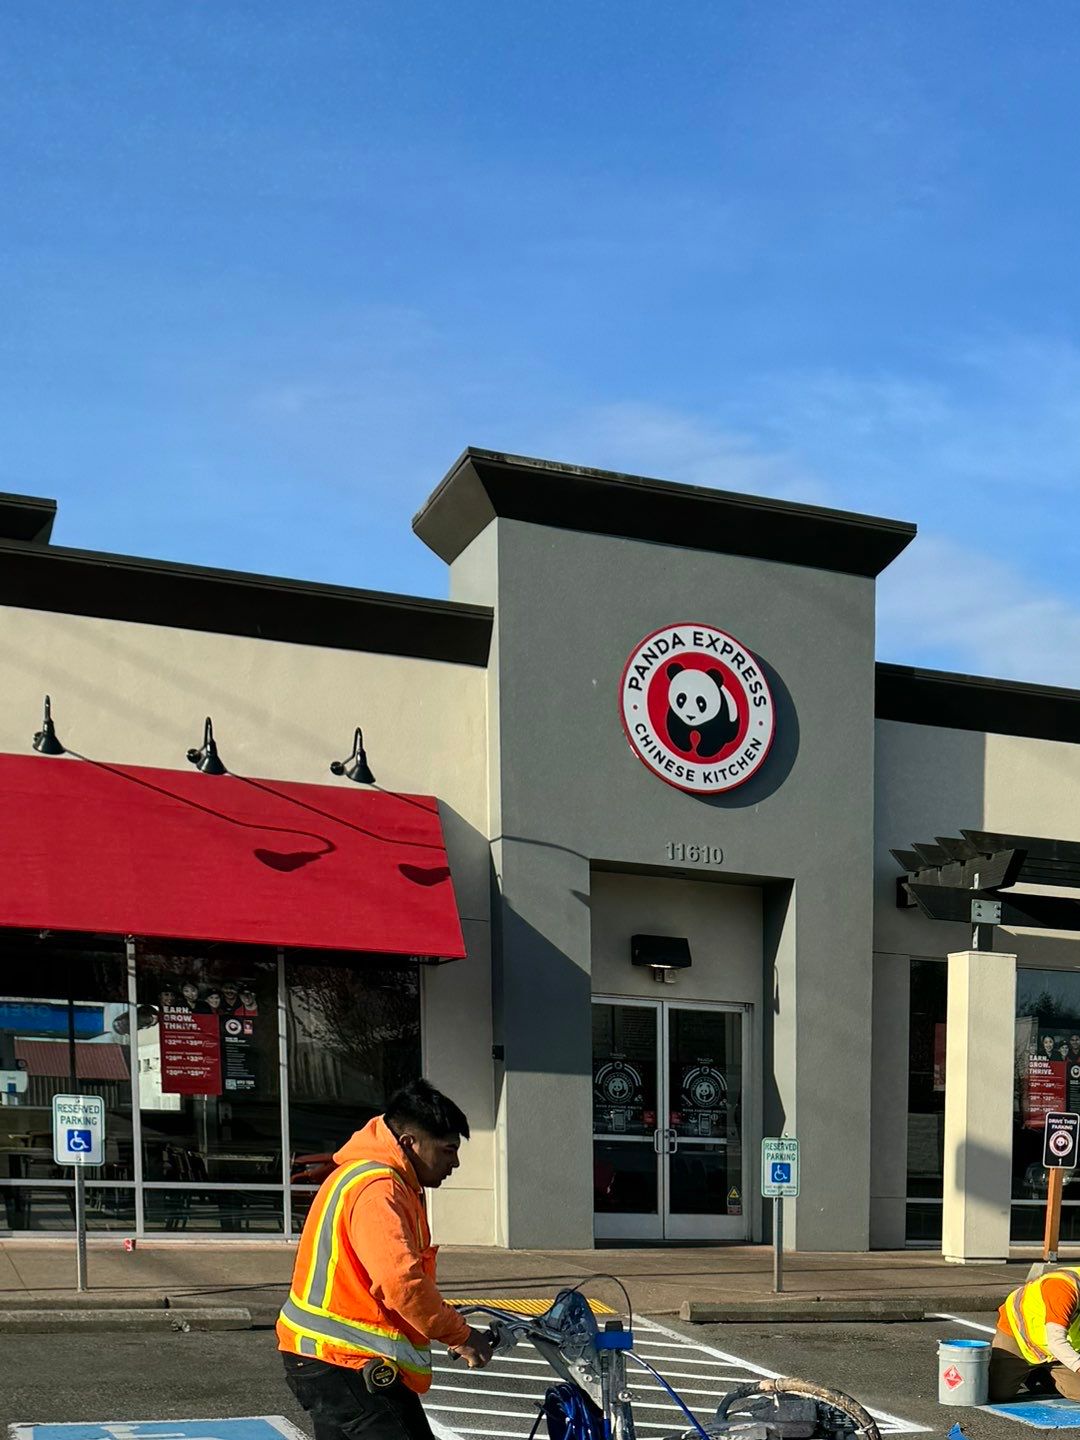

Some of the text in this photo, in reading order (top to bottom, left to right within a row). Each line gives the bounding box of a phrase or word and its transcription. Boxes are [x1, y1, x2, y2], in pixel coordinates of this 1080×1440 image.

[628, 631, 767, 708] PANDA EXPRESS
[635, 722, 762, 784] CHINESE KITCHEN
[665, 841, 724, 864] 11610
[163, 1005, 192, 1014] EARN.
[164, 1022, 201, 1031] THRIVE.
[57, 1104, 100, 1114] RESERVED
[60, 1116, 97, 1126] PARKING
[765, 1142, 797, 1151] RESERVED
[766, 1152, 796, 1161] PARKING
[1058, 1158, 1062, 1166] 1
